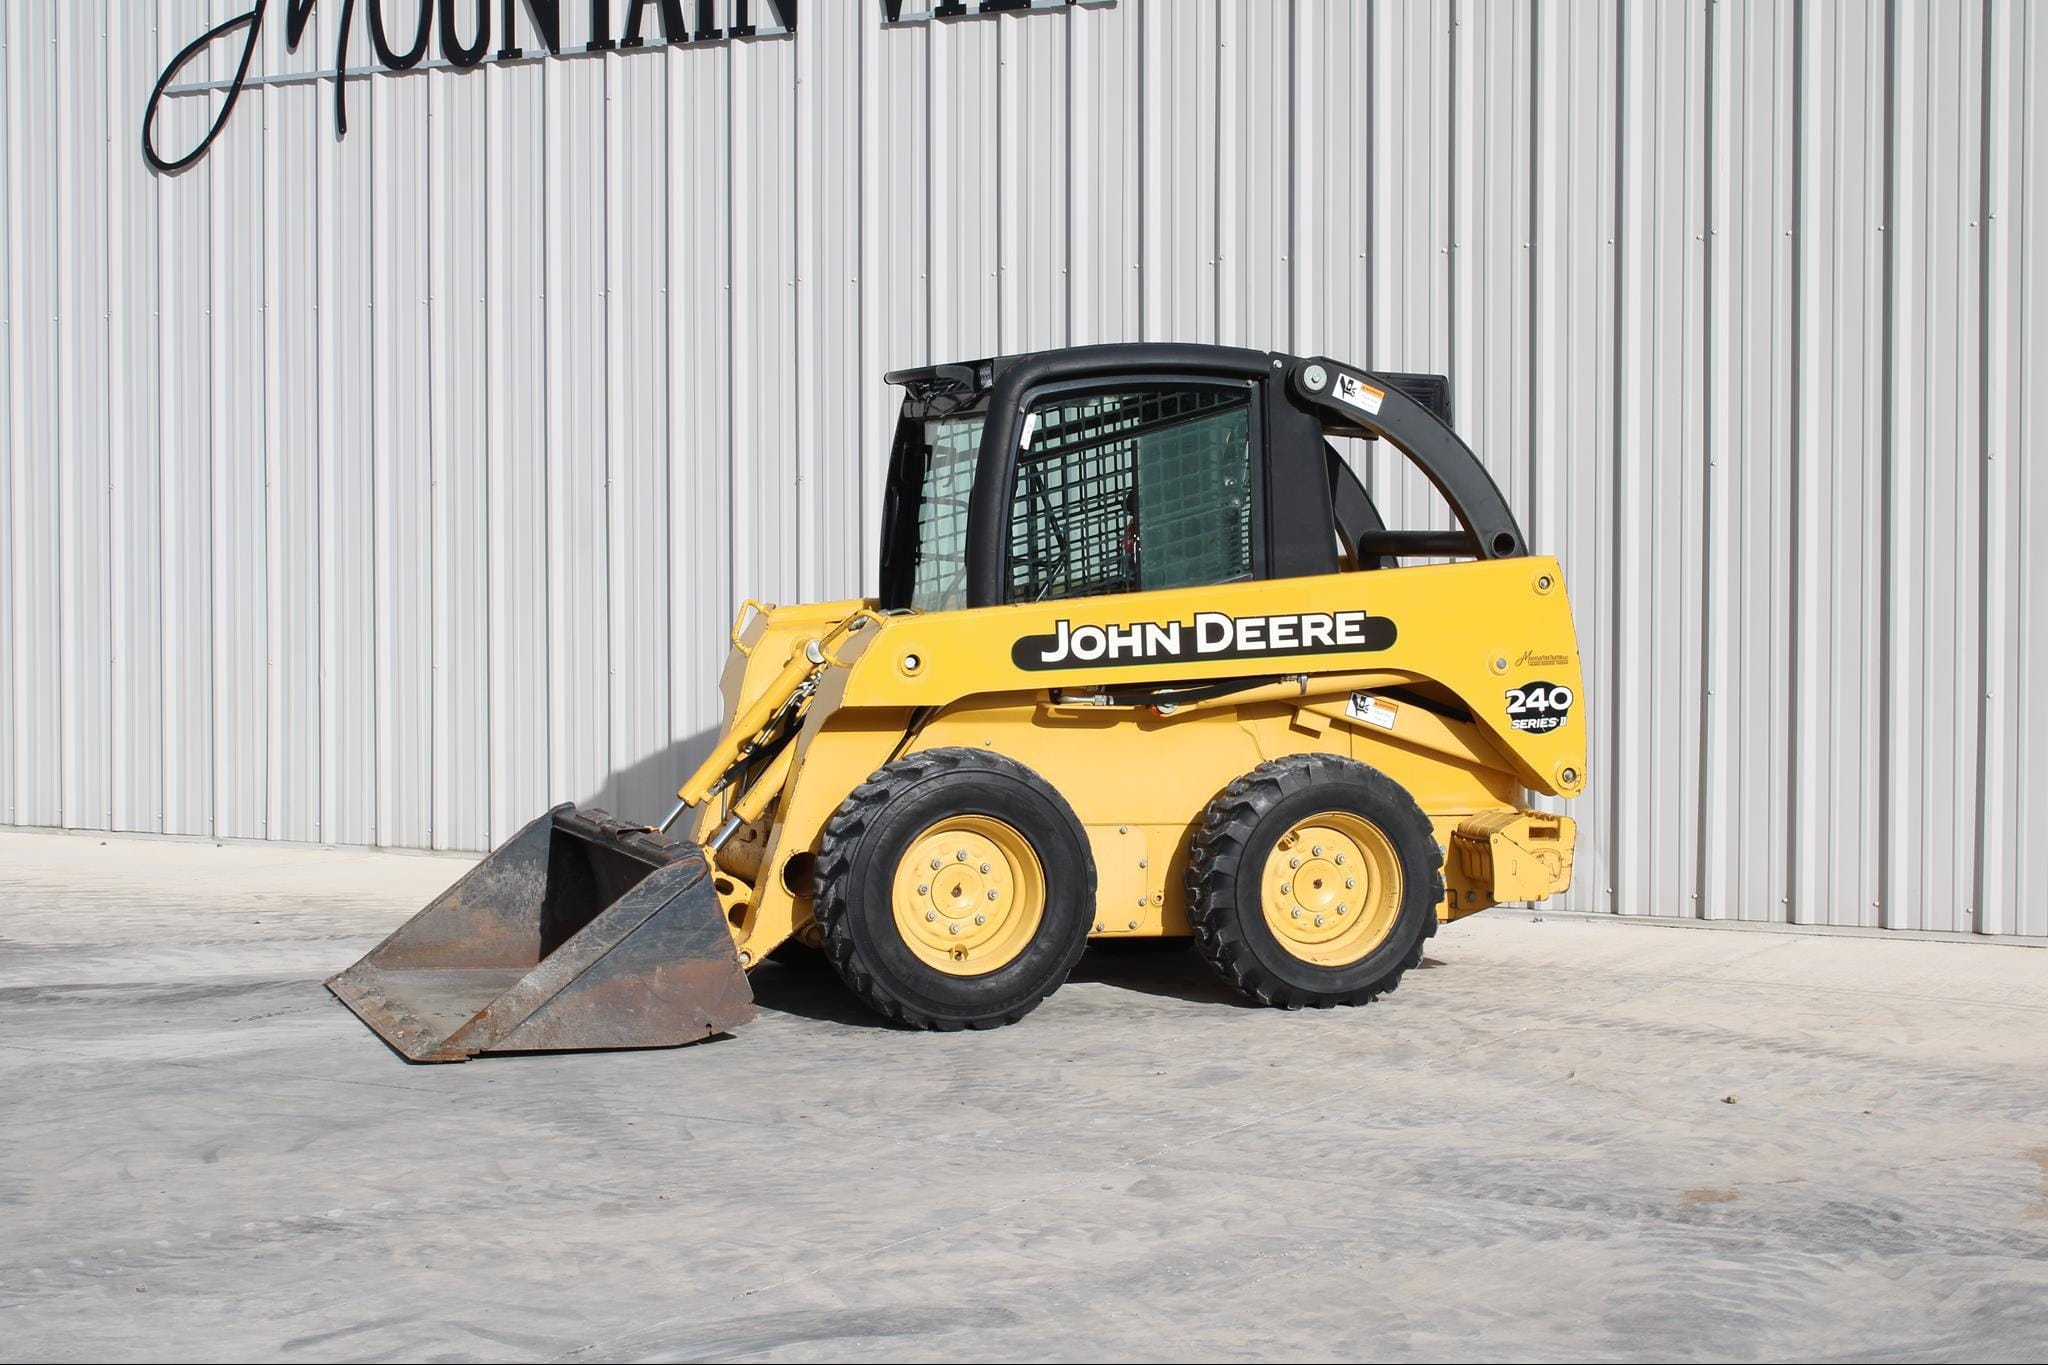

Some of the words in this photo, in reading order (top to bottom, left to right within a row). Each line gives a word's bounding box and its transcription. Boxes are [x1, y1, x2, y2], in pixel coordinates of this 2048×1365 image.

[1041, 619, 1181, 663] JOHN
[1195, 611, 1367, 654] DEERE
[1505, 686, 1573, 714] 240
[1511, 717, 1557, 729] SERIES
